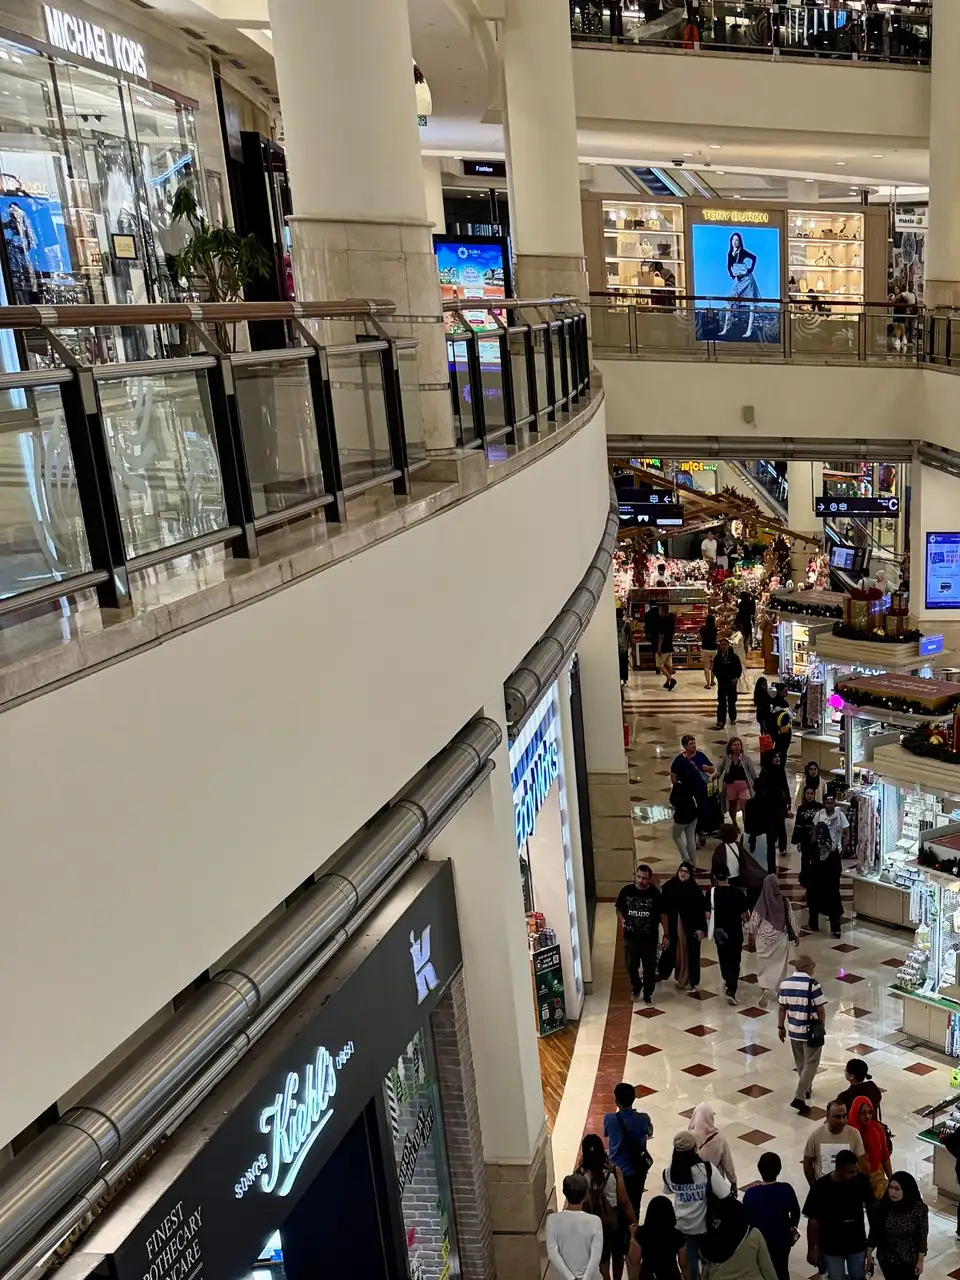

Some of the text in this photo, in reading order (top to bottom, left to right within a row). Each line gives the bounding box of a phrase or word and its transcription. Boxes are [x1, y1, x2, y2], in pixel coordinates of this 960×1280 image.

[44, 4, 148, 79] MICHAEL KORS
[702, 209, 769, 223] TORY BURCH
[888, 498, 898, 511] C
[259, 1046, 337, 1193] Kiehl's
[234, 1153, 269, 1199] SINCE
[145, 1201, 184, 1260] FINEST
